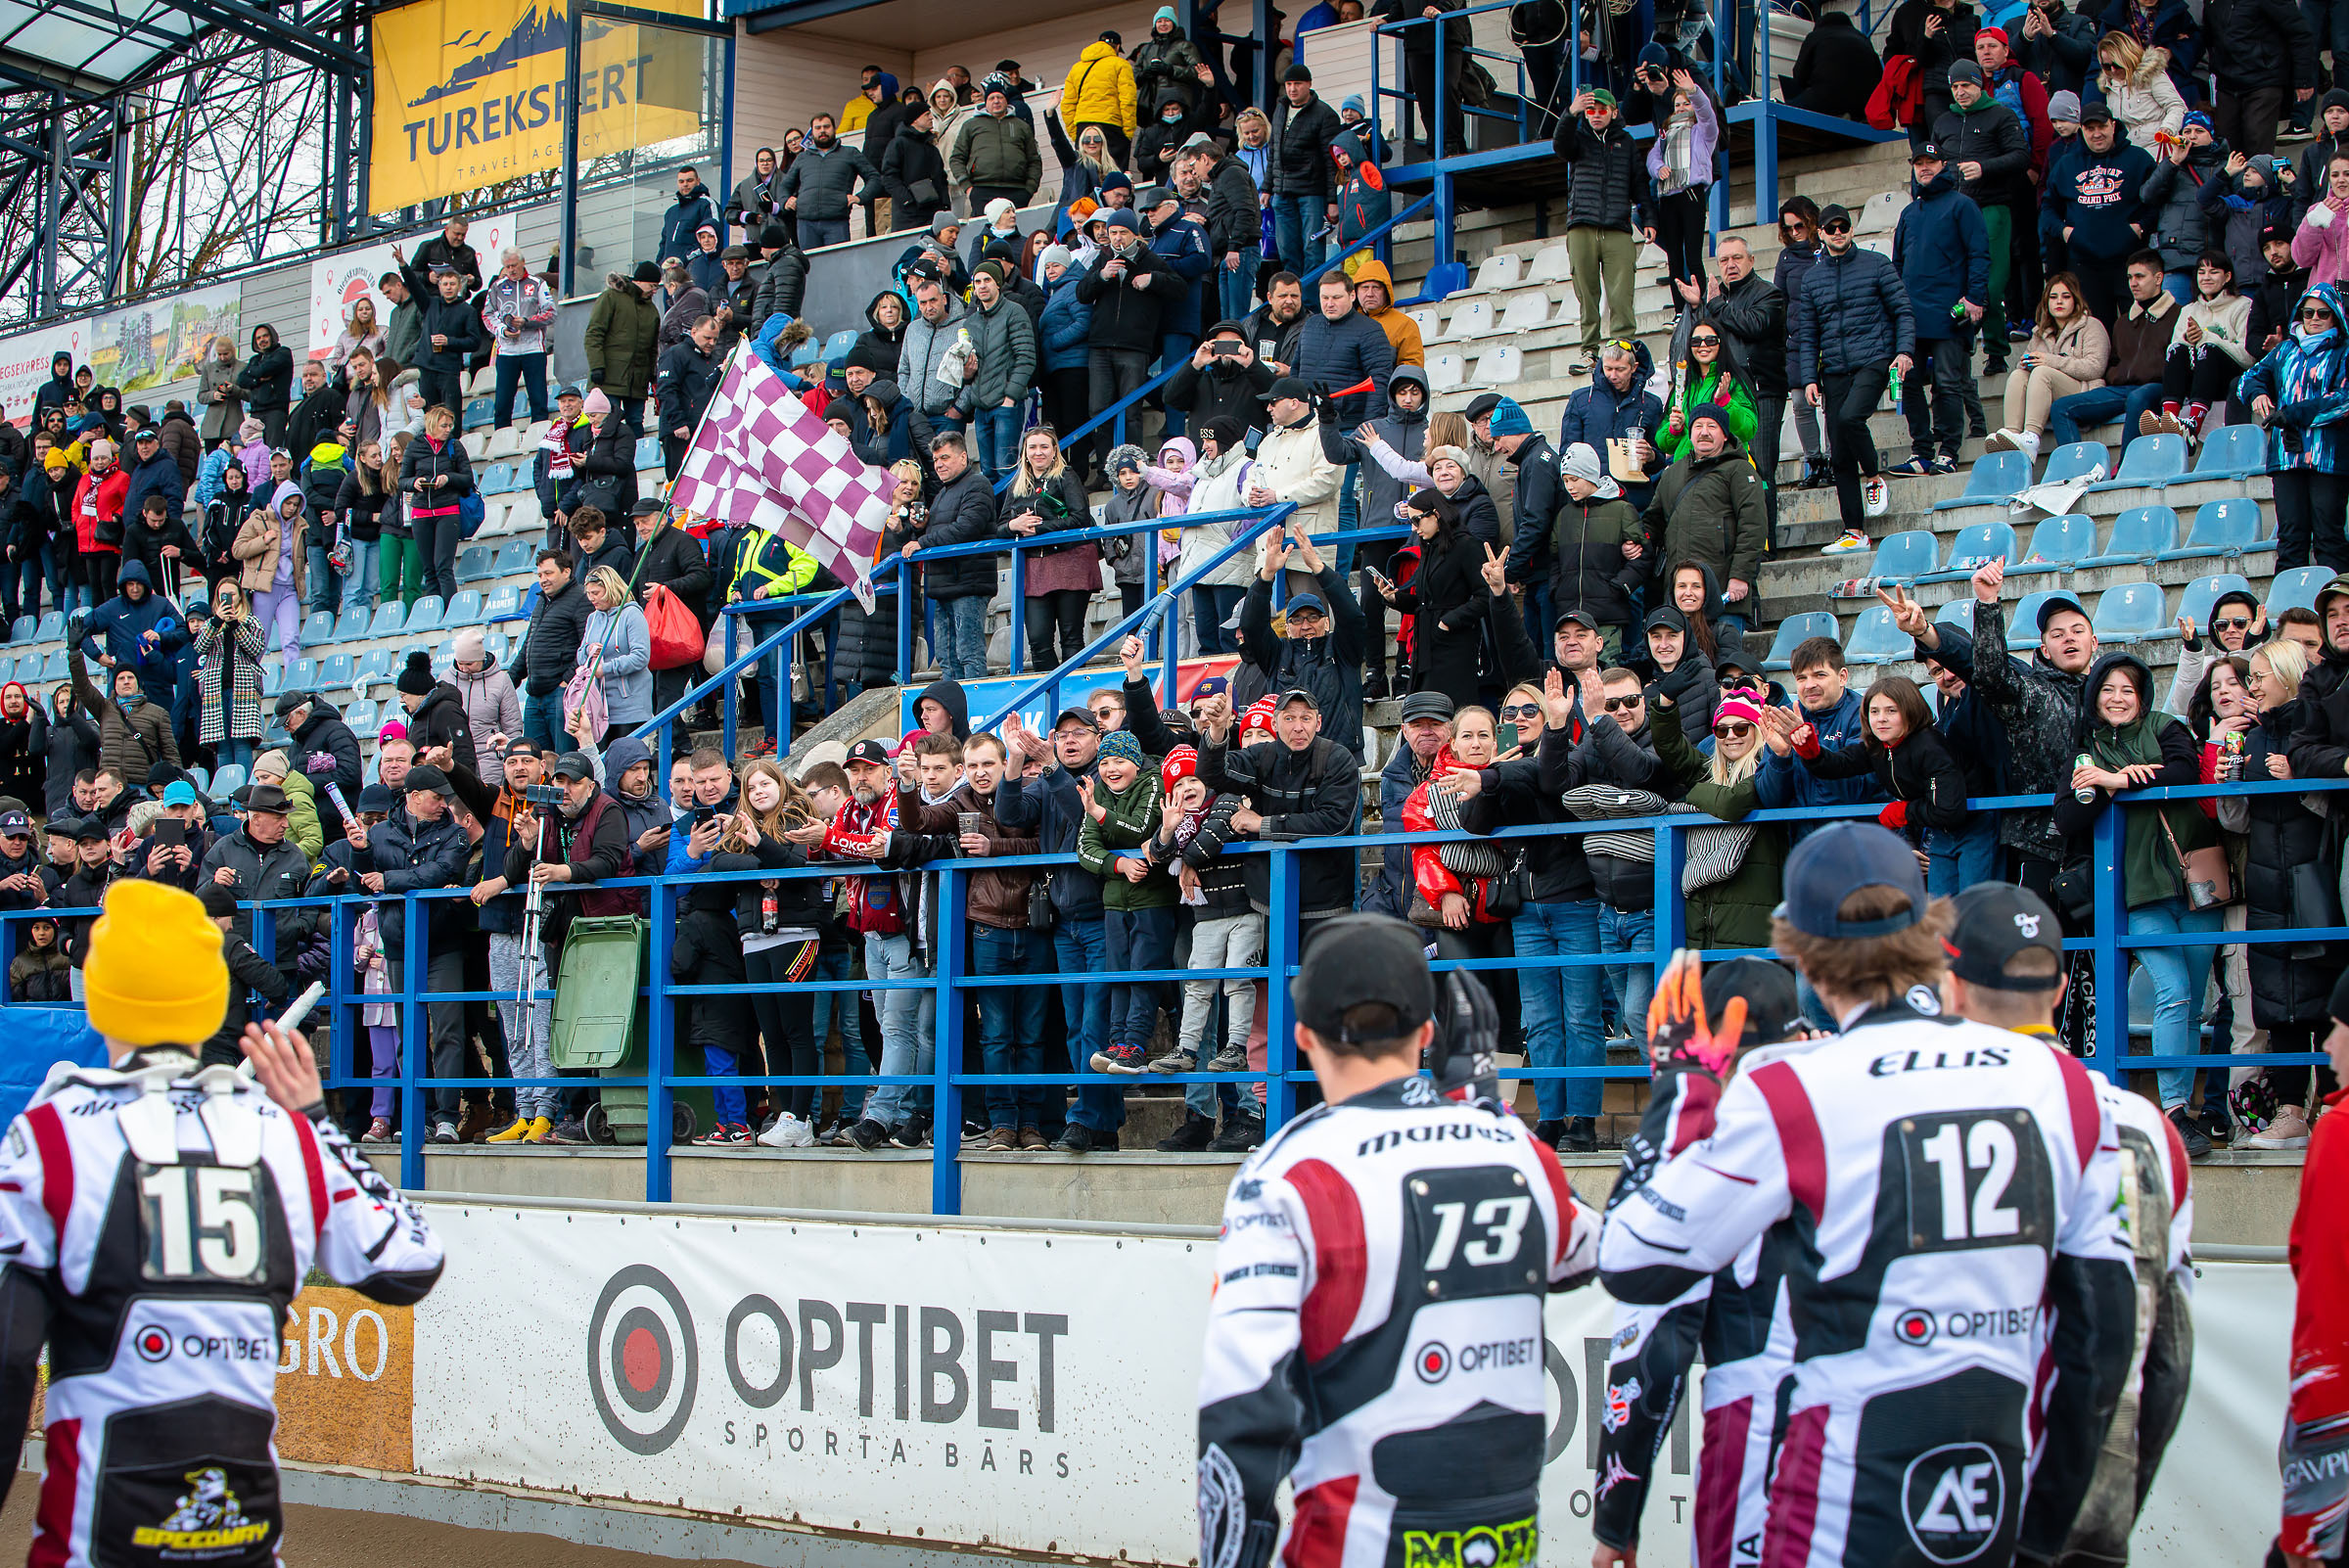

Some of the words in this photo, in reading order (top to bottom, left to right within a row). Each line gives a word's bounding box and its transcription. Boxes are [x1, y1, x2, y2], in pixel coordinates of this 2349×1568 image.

[457, 154, 519, 180] TRAVEL
[532, 132, 603, 160] AGECY
[1885, 194, 1891, 203] 6
[2078, 195, 2101, 205] GRAND
[2103, 192, 2122, 204] PRIX
[1498, 257, 1504, 266] 2
[1418, 313, 1424, 322] 2
[1500, 349, 1506, 358] 5
[1442, 357, 1448, 366] 4
[2230, 431, 2237, 442] 4
[2152, 438, 2160, 450] 3
[2075, 445, 2084, 459] 2
[1999, 457, 2004, 469] 1
[2141, 510, 2148, 523] 4
[2217, 504, 2228, 519] 5
[2061, 520, 2069, 532] 3
[1982, 529, 1991, 541] 2
[1905, 536, 1910, 550] 1
[1001, 573, 1006, 582] 1
[2300, 573, 2309, 586] 7
[2210, 578, 2219, 592] 6
[462, 593, 471, 603] 11
[2126, 590, 2135, 604] 5
[1881, 609, 1890, 623] 2
[1961, 603, 1970, 618] 3
[316, 615, 324, 624] 15
[1806, 618, 1811, 631] 1
[373, 652, 380, 662] 11
[8, 816, 23, 825] AJ
[831, 835, 868, 852] LOKO
[1868, 1047, 2010, 1079] ELLIS
[1922, 1119, 2019, 1241] 12
[141, 1166, 261, 1278] 15
[1424, 1195, 1531, 1271] 13
[183, 1335, 270, 1360] OPTIBET
[1459, 1337, 1536, 1370] OPTIBET
[724, 1294, 1069, 1433] OPTIBET
[724, 1420, 906, 1463] SPORTA
[945, 1439, 1069, 1479] BĀRS
[131, 1520, 270, 1549] SPEEDWAY
